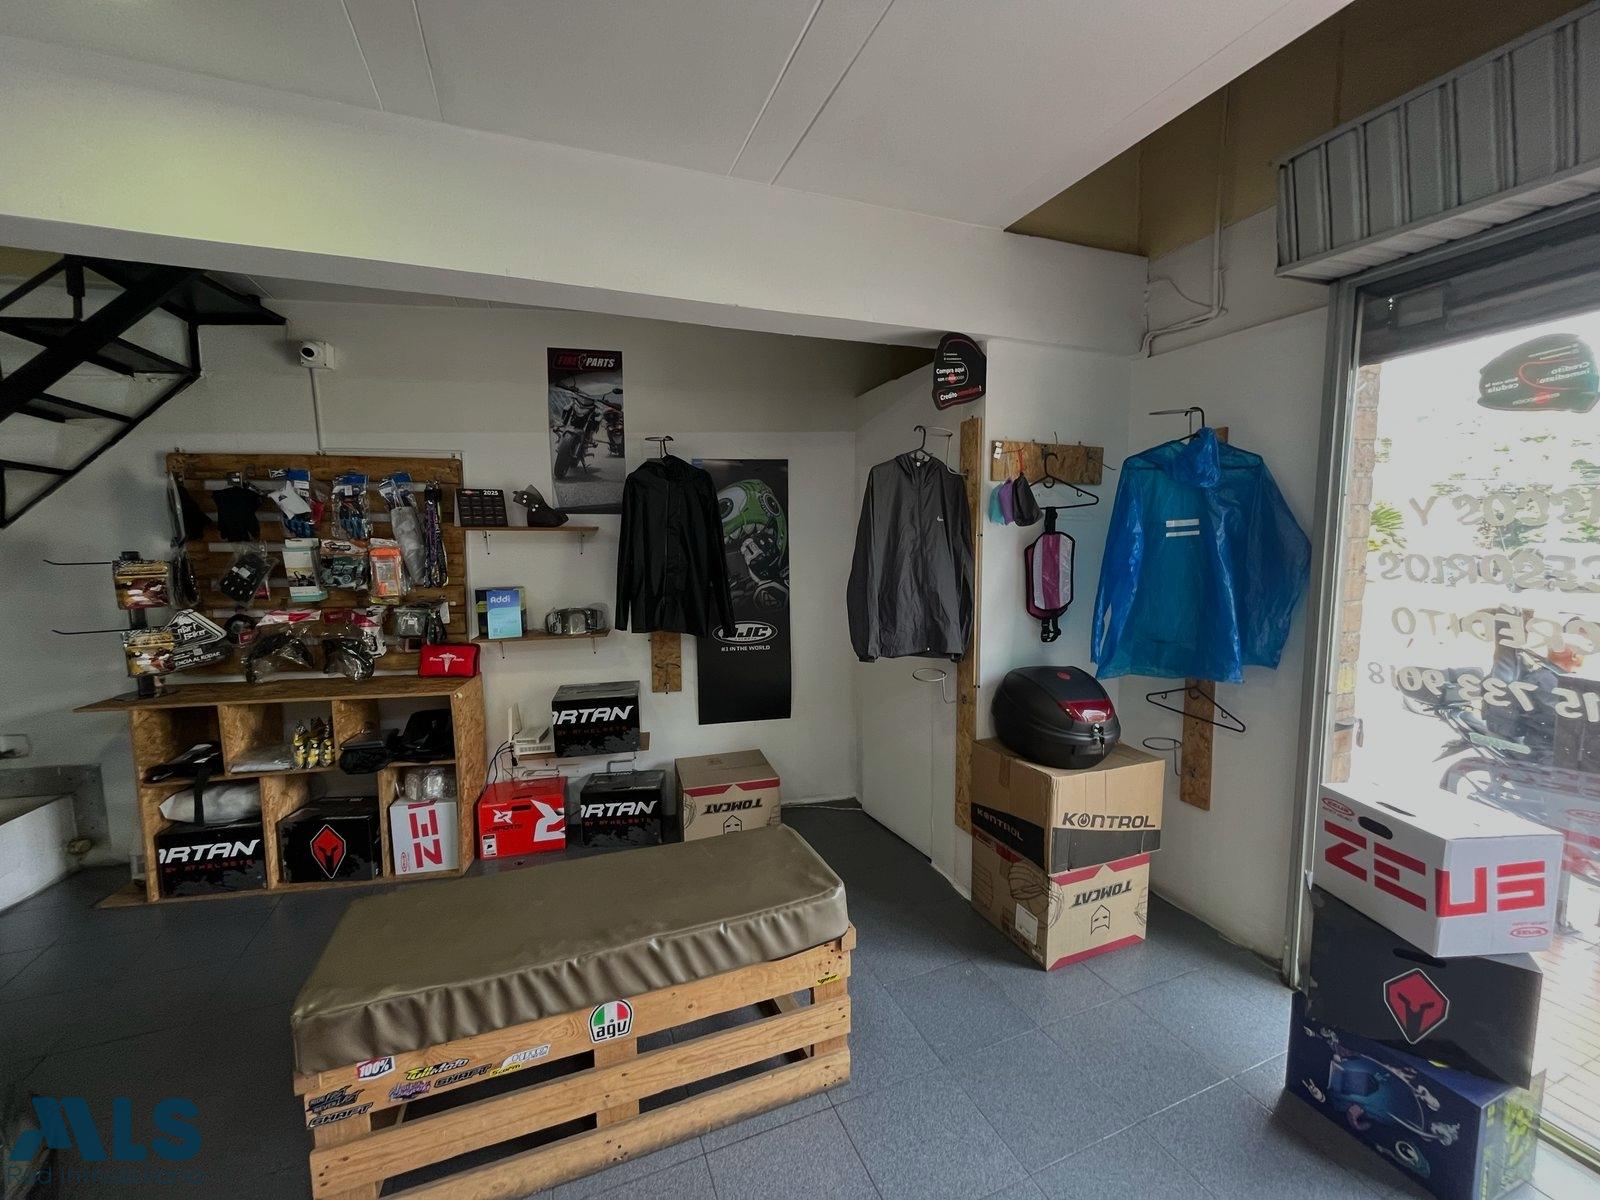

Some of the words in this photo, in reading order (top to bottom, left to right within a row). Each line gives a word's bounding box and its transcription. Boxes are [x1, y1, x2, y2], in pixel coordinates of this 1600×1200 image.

[585, 357, 615, 368] PARTS
[936, 367, 954, 375] Compra
[490, 595, 511, 604] Addi
[701, 798, 763, 815] TOMCAT
[1324, 819, 1546, 918] ZEUS
[1070, 880, 1133, 909] TOMCAT
[597, 1019, 627, 1038] agv
[360, 1059, 390, 1078] 100%
